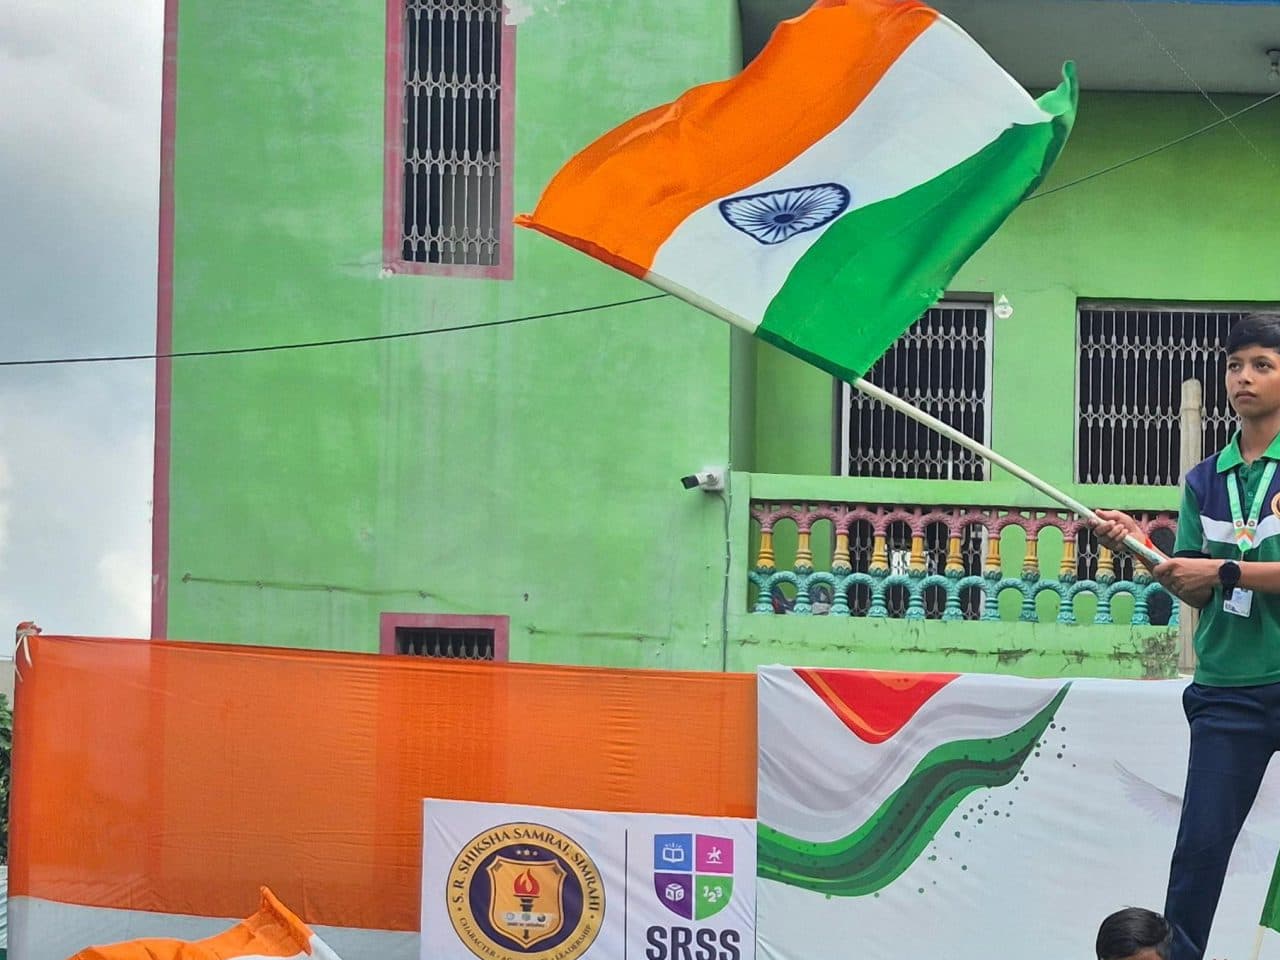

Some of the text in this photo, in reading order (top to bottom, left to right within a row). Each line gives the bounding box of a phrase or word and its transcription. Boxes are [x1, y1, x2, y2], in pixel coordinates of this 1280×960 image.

[458, 830, 511, 875] SHIKSHA
[571, 852, 600, 912] SIMRAHI
[459, 917, 497, 957] CHARACTER
[555, 923, 592, 960] LEADERSHIP
